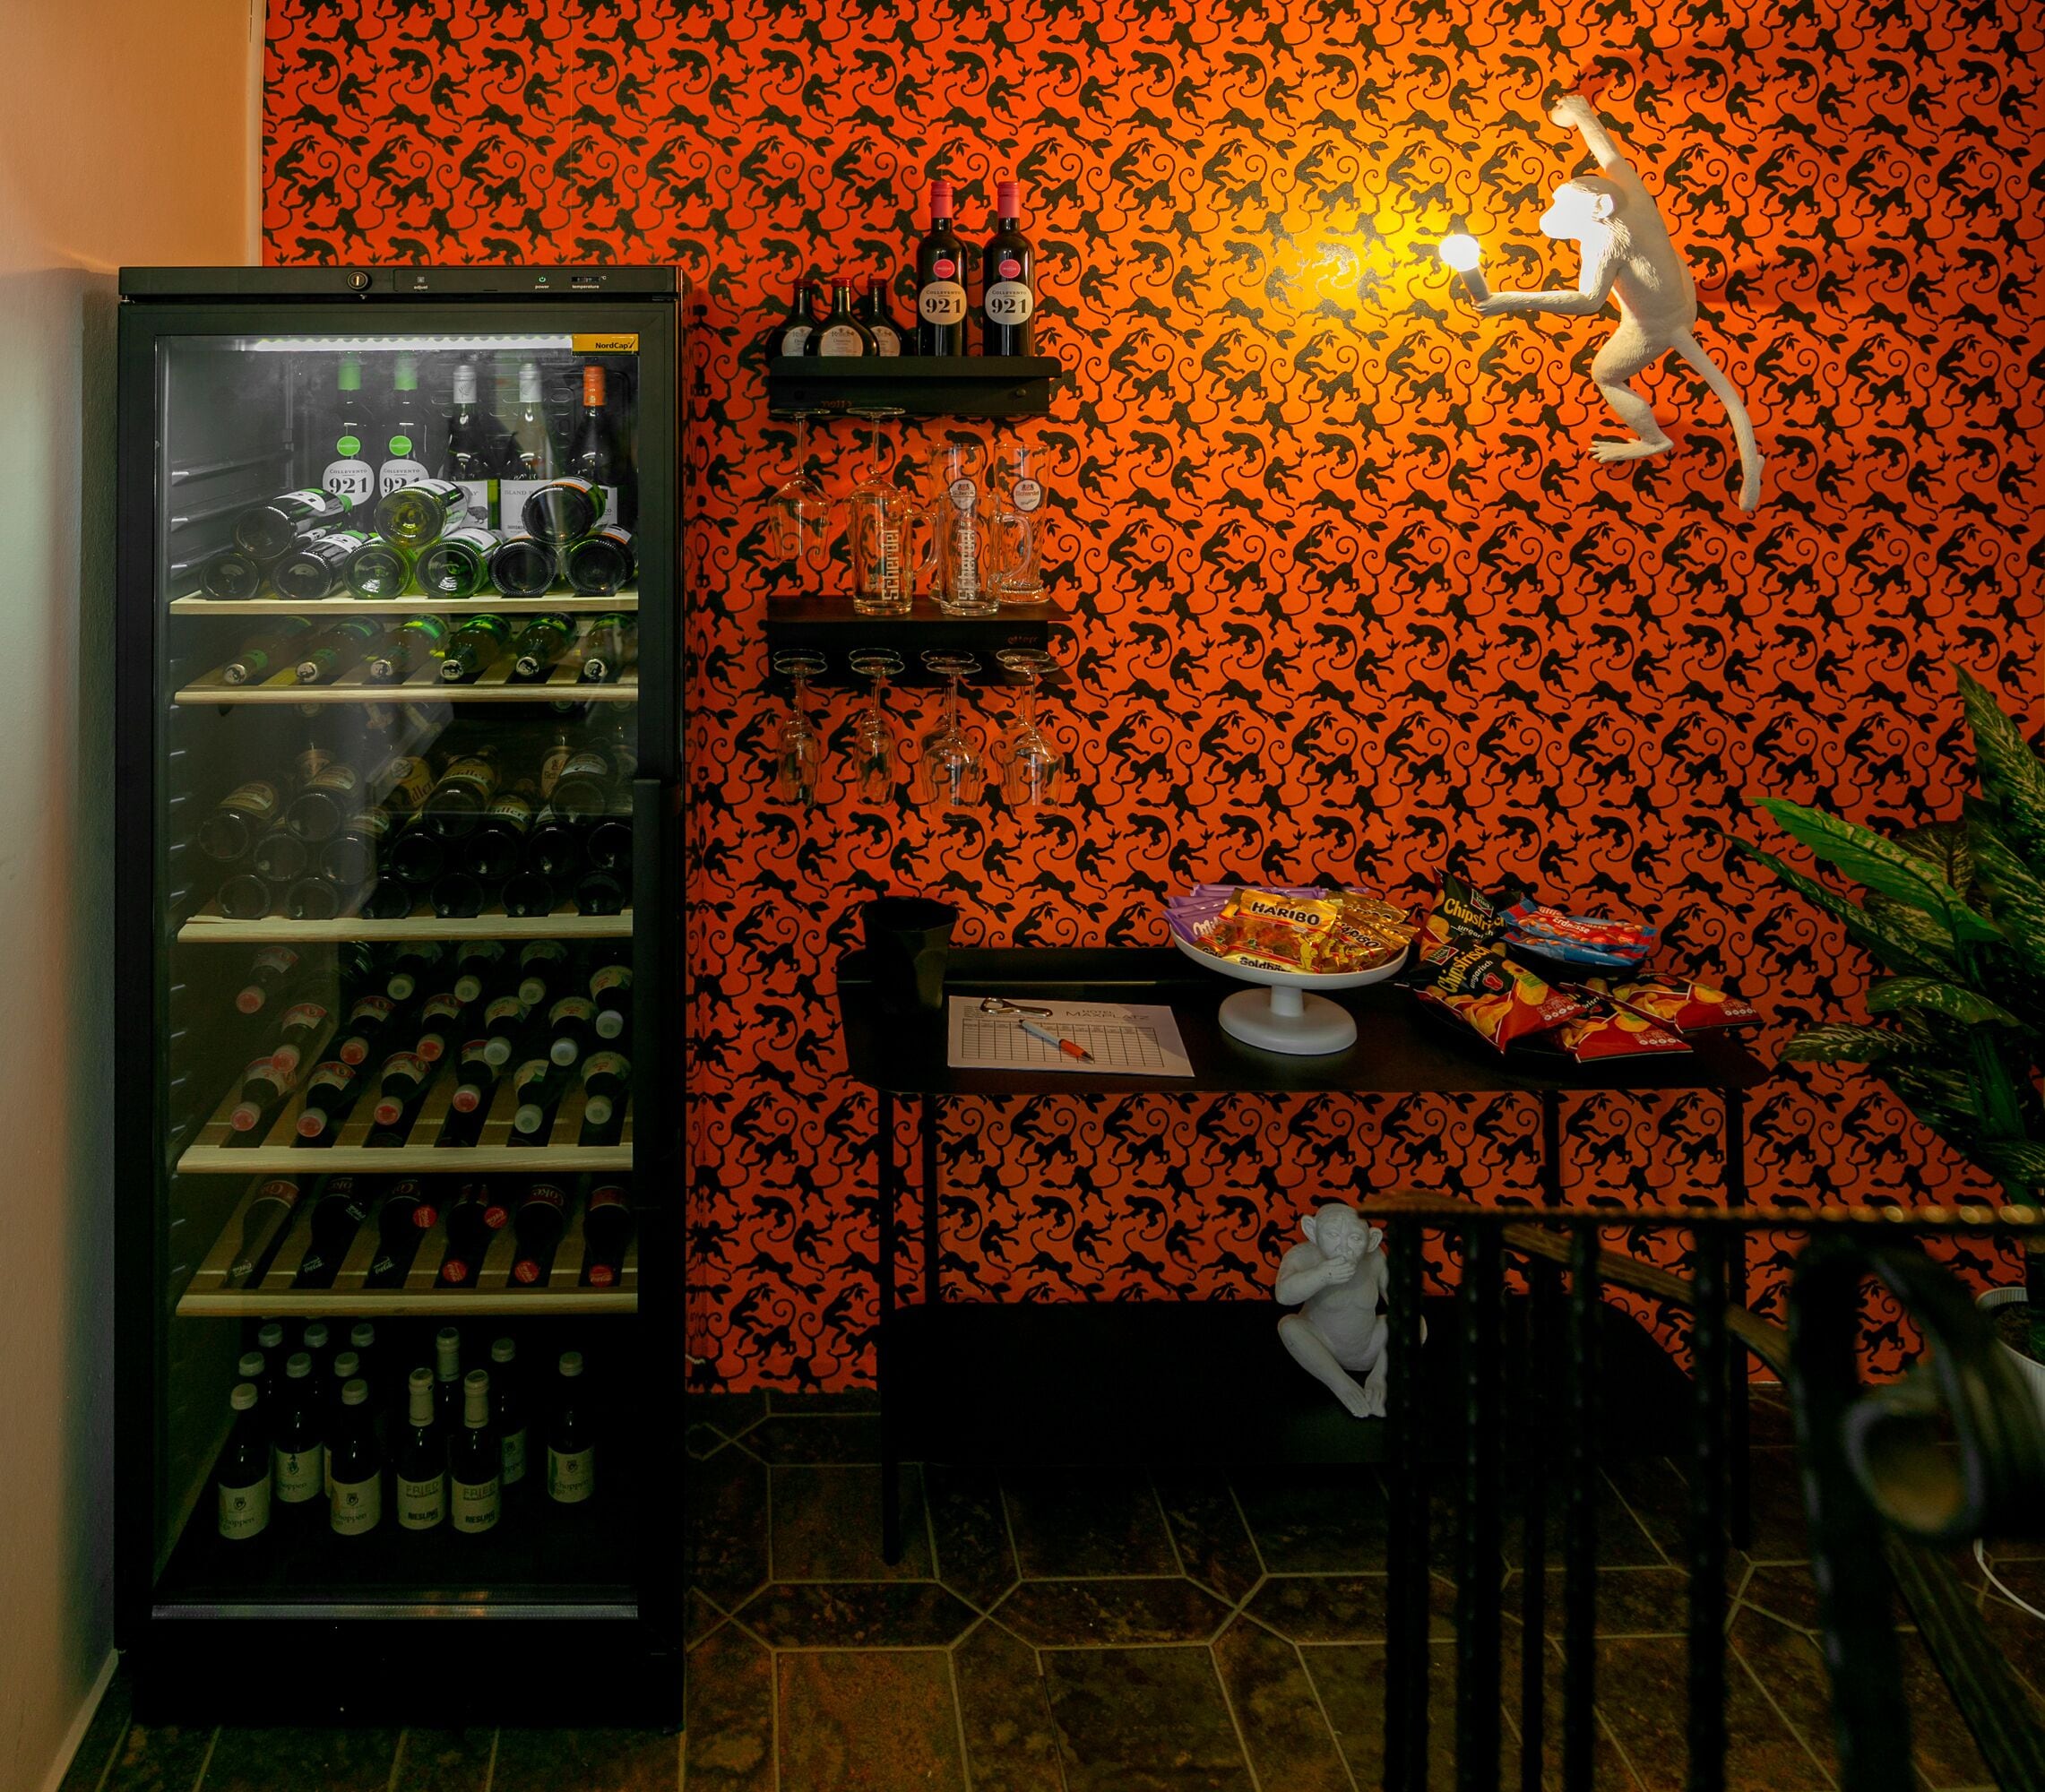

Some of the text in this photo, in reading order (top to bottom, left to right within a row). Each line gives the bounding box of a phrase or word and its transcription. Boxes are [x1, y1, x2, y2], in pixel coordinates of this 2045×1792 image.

[925, 298, 962, 314] 921
[991, 298, 1027, 314] 921
[595, 342, 629, 350] NordCap
[329, 477, 367, 494] 921
[882, 529, 900, 601] Scherdel
[1251, 901, 1321, 926] HARIBO
[1437, 943, 1493, 994] Chipsfrisch
[1469, 960, 1494, 989] ungarisch
[408, 1507, 438, 1521] RIESLING
[465, 1510, 496, 1523] RIESLING
